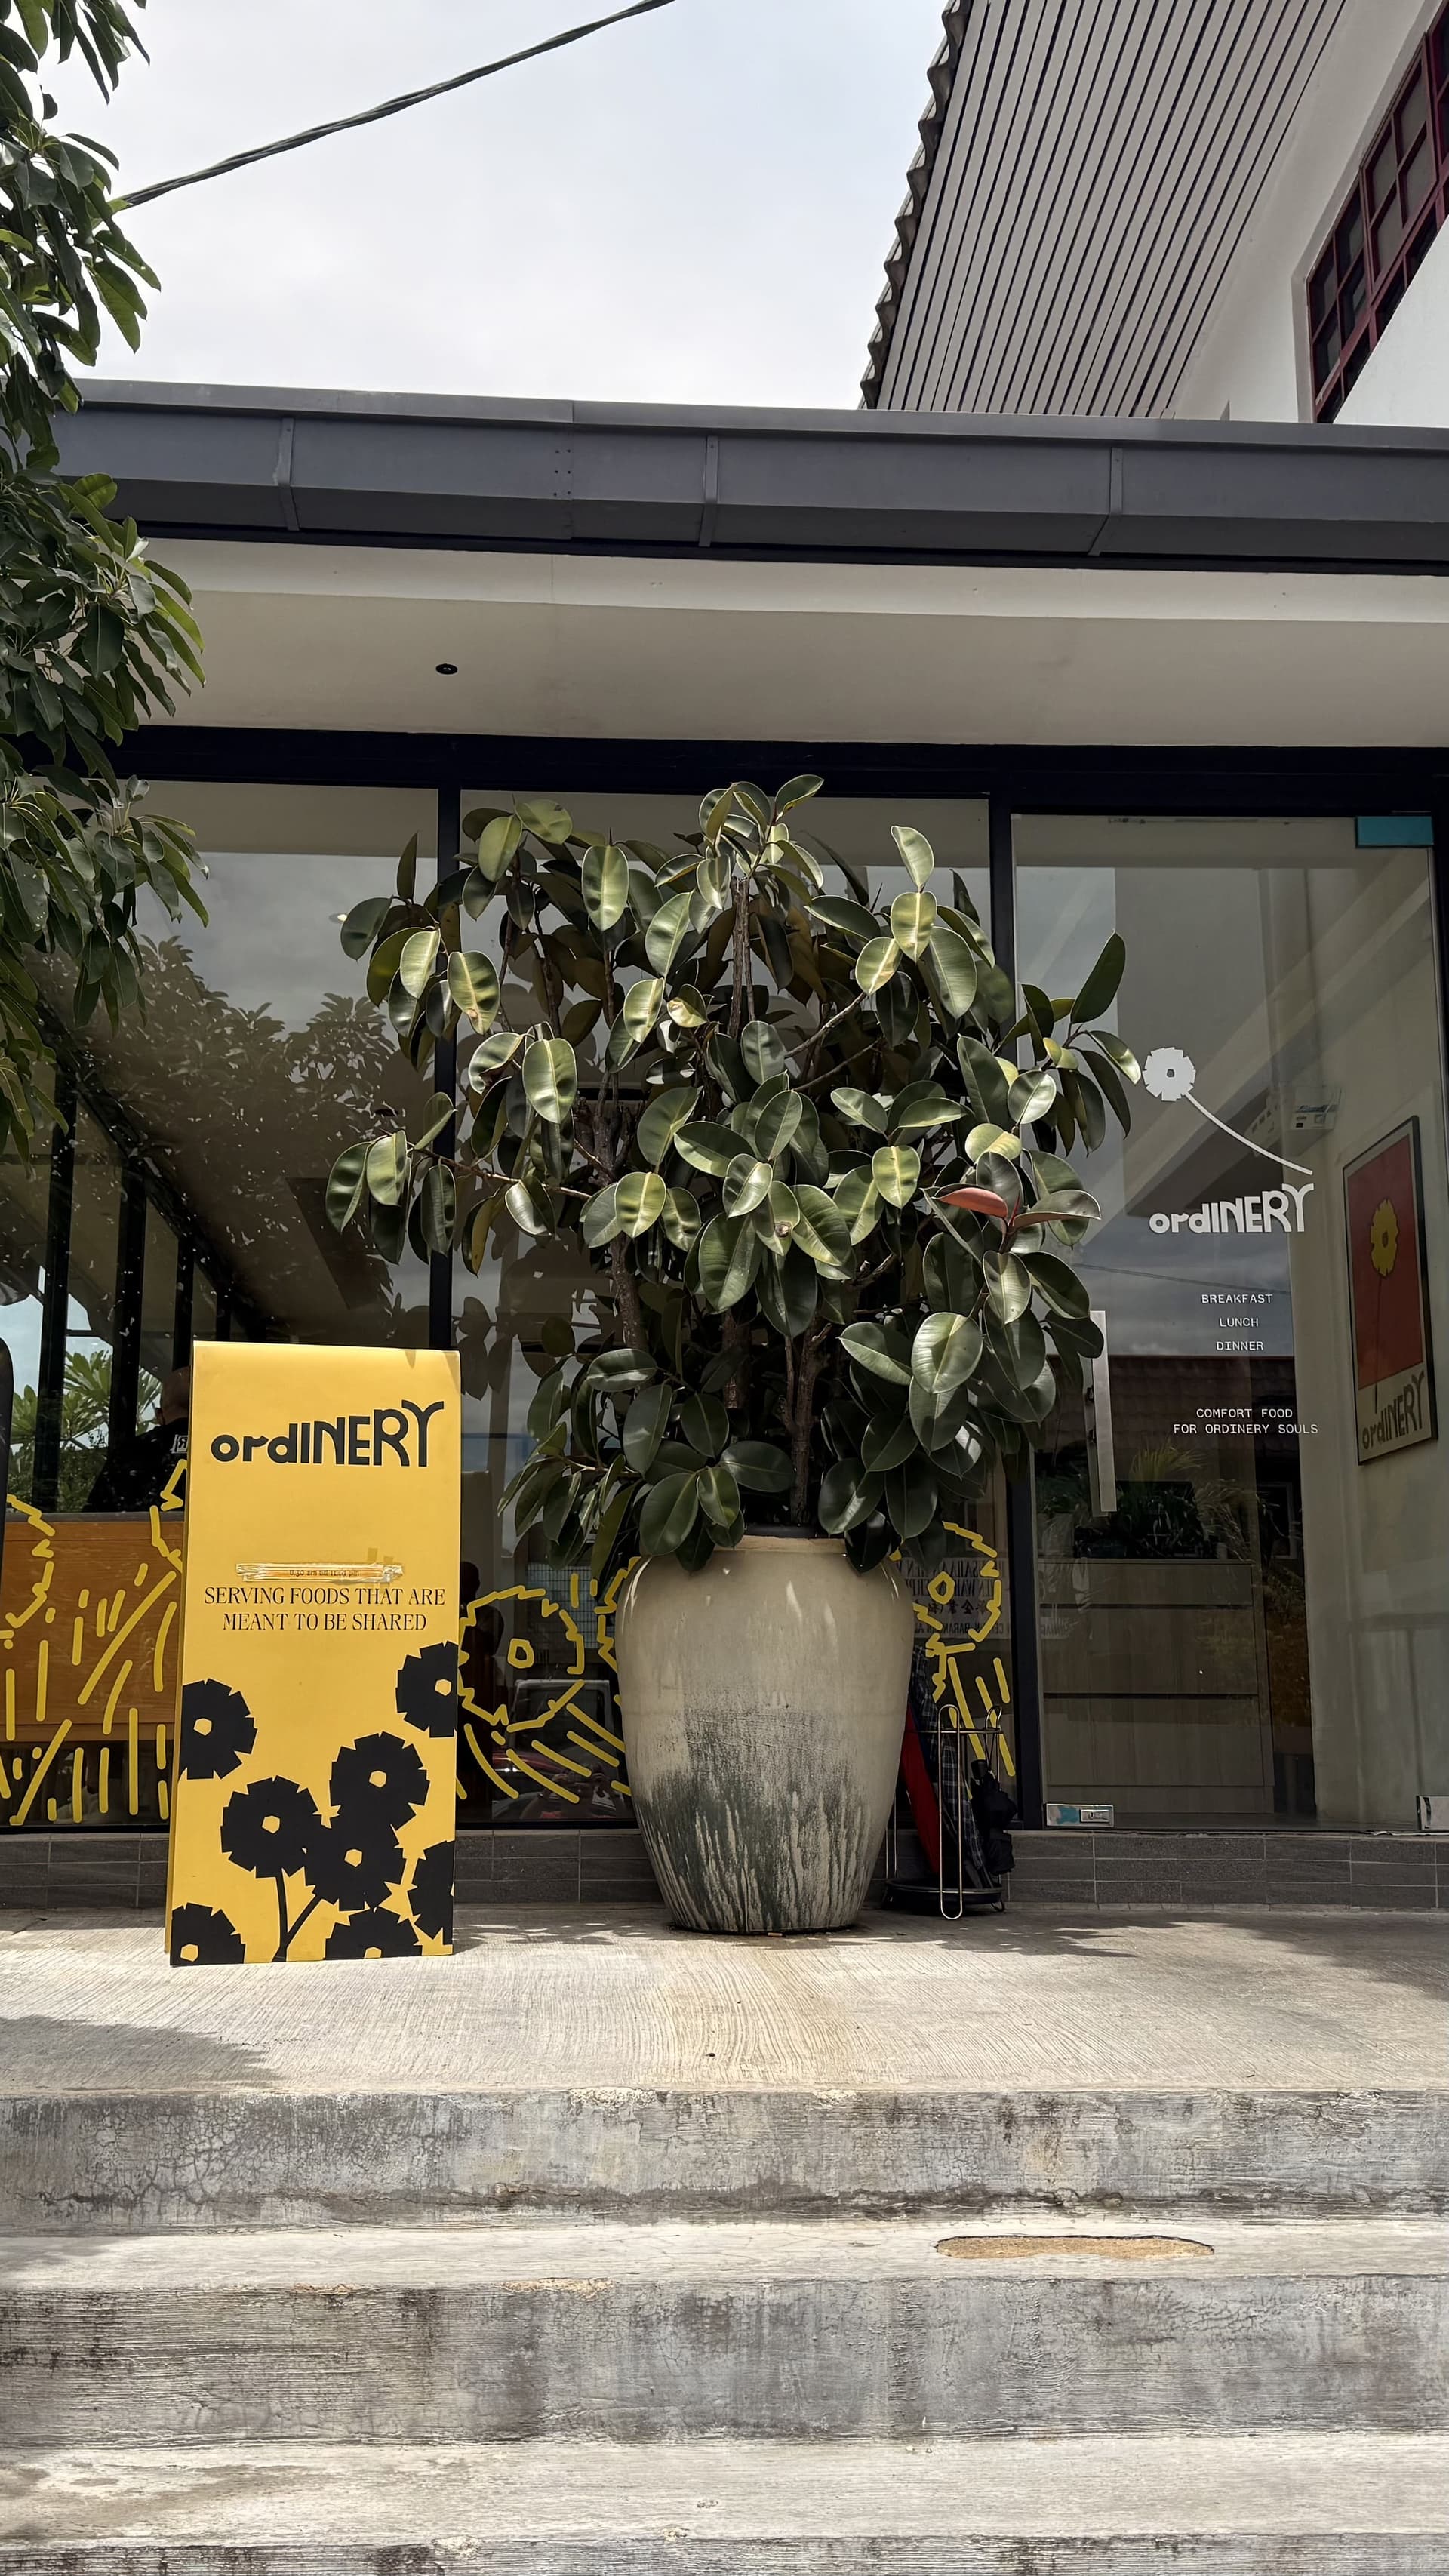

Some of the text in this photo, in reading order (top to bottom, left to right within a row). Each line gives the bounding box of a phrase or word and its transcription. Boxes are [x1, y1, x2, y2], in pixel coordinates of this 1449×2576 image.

[1201, 1294, 1272, 1303] BREAKFAST
[1219, 1317, 1259, 1327] LUNCH
[1216, 1340, 1263, 1350] DINNER
[1196, 1408, 1293, 1418] COMFORT FOOD
[1174, 1423, 1318, 1434] FOR ORDINERY SOULS
[205, 1587, 445, 1605] SERVING FOODS THAT ARE
[223, 1613, 426, 1631] MEANT TO BE SHARED
